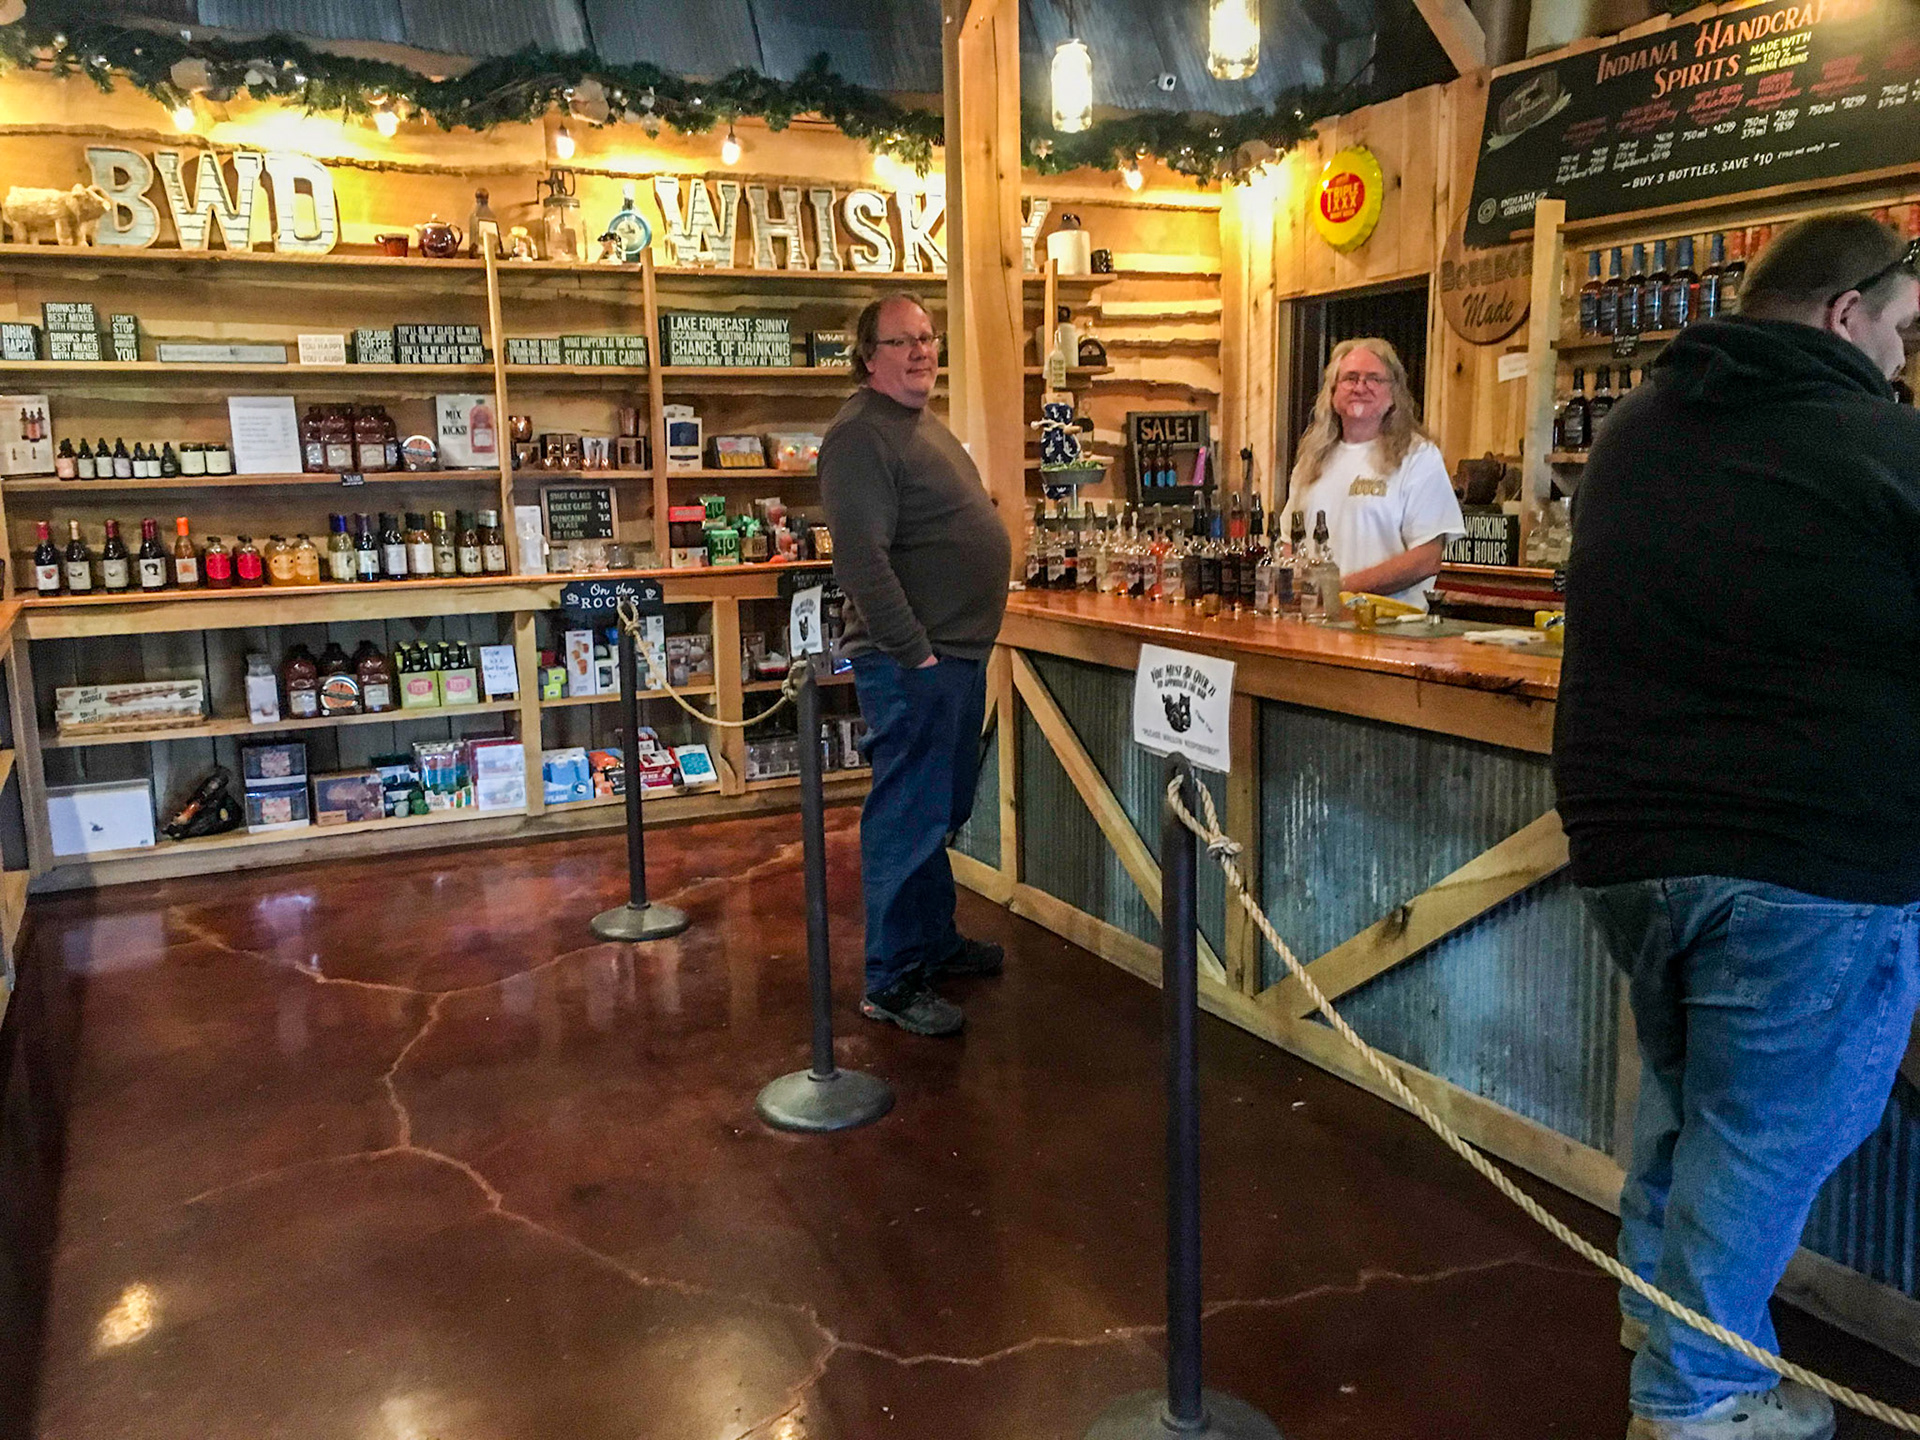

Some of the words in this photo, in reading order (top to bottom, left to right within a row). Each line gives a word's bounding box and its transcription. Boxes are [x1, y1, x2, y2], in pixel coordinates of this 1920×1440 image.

[1750, 37, 1779, 55] MADE
[1781, 31, 1811, 48] WITH
[1597, 40, 1678, 85] INDIANA
[1745, 61, 1778, 76] INDIANA
[1779, 51, 1809, 69] GRAINS
[1652, 54, 1742, 99] SPIRITS
[1632, 176, 1654, 188] BUY
[1657, 175, 1664, 184] 3
[1667, 162, 1719, 182] BOTTLES,
[1721, 156, 1749, 172] SAVE
[1753, 152, 1773, 166] $10
[84, 144, 338, 255] BWD
[1325, 182, 1360, 211] TRIPLE
[1333, 195, 1357, 211] XXX
[1500, 192, 1535, 208] INDIANA
[1503, 202, 1536, 216] GROWN
[654, 176, 1051, 273] WHISKY
[46, 303, 76, 313] DRINKS
[78, 304, 93, 313] ARE
[1463, 291, 1513, 328] Made
[47, 313, 67, 322] BEST
[68, 313, 94, 323] MIXED
[115, 315, 134, 323] CAN'T
[66, 323, 95, 331] FRIENDS
[113, 323, 135, 333] STOP
[426, 326, 436, 334] MY
[670, 317, 696, 331] LAKE
[699, 318, 753, 332] FORECAST:
[755, 319, 789, 333] SUNNY
[2, 325, 33, 339] DRINK
[50, 333, 80, 342] DRINKS
[82, 333, 97, 342] ARE
[671, 331, 714, 340] OCCASIONAL
[717, 332, 746, 341] BOATING
[747, 333, 752, 341] &
[753, 333, 789, 342] SWIMMING
[818, 333, 844, 342] WHAT
[4, 339, 34, 352] HAPPY
[51, 343, 71, 352] BEST
[73, 343, 98, 352] MIXED
[114, 340, 136, 348] ABOUT
[359, 338, 392, 349] COFFEE
[563, 337, 580, 347] WHAT
[581, 337, 607, 347] HAPPENS
[608, 338, 615, 347] AT
[616, 338, 625, 347] THE
[115, 348, 137, 361] YOU
[401, 346, 420, 354] YOU'LL
[421, 346, 428, 354] BE
[430, 346, 439, 354] MY
[441, 346, 458, 355] GLASS
[460, 346, 466, 354] OF
[671, 342, 717, 356] CHANCE
[722, 342, 735, 356] OF
[738, 343, 790, 356] DRINKING
[52, 352, 70, 360] WITH
[71, 352, 99, 360] FRIENDS
[360, 354, 393, 363] ALCOHOL
[412, 354, 419, 363] BE
[565, 350, 590, 365] STAYS
[592, 350, 601, 365] AT
[602, 350, 617, 365] THE
[672, 356, 706, 366] DRINKING
[707, 356, 722, 366] MAY
[724, 356, 734, 366] BE
[735, 357, 758, 366] HEAVY
[760, 357, 768, 366] AT
[770, 357, 790, 366] TIMES
[820, 357, 851, 367] STAYS
[445, 410, 461, 420] MIX
[1141, 418, 1192, 441] SALE!
[570, 491, 591, 500] GLASS
[572, 502, 592, 510] GLASS
[1465, 516, 1508, 540] WORKING
[1473, 542, 1507, 565] HOURS
[590, 583, 610, 596] On
[615, 583, 635, 594] the
[581, 595, 639, 609] ROCS
[1166, 664, 1182, 677] MUST
[1183, 665, 1193, 679] BE
[1194, 670, 1209, 689] OVER
